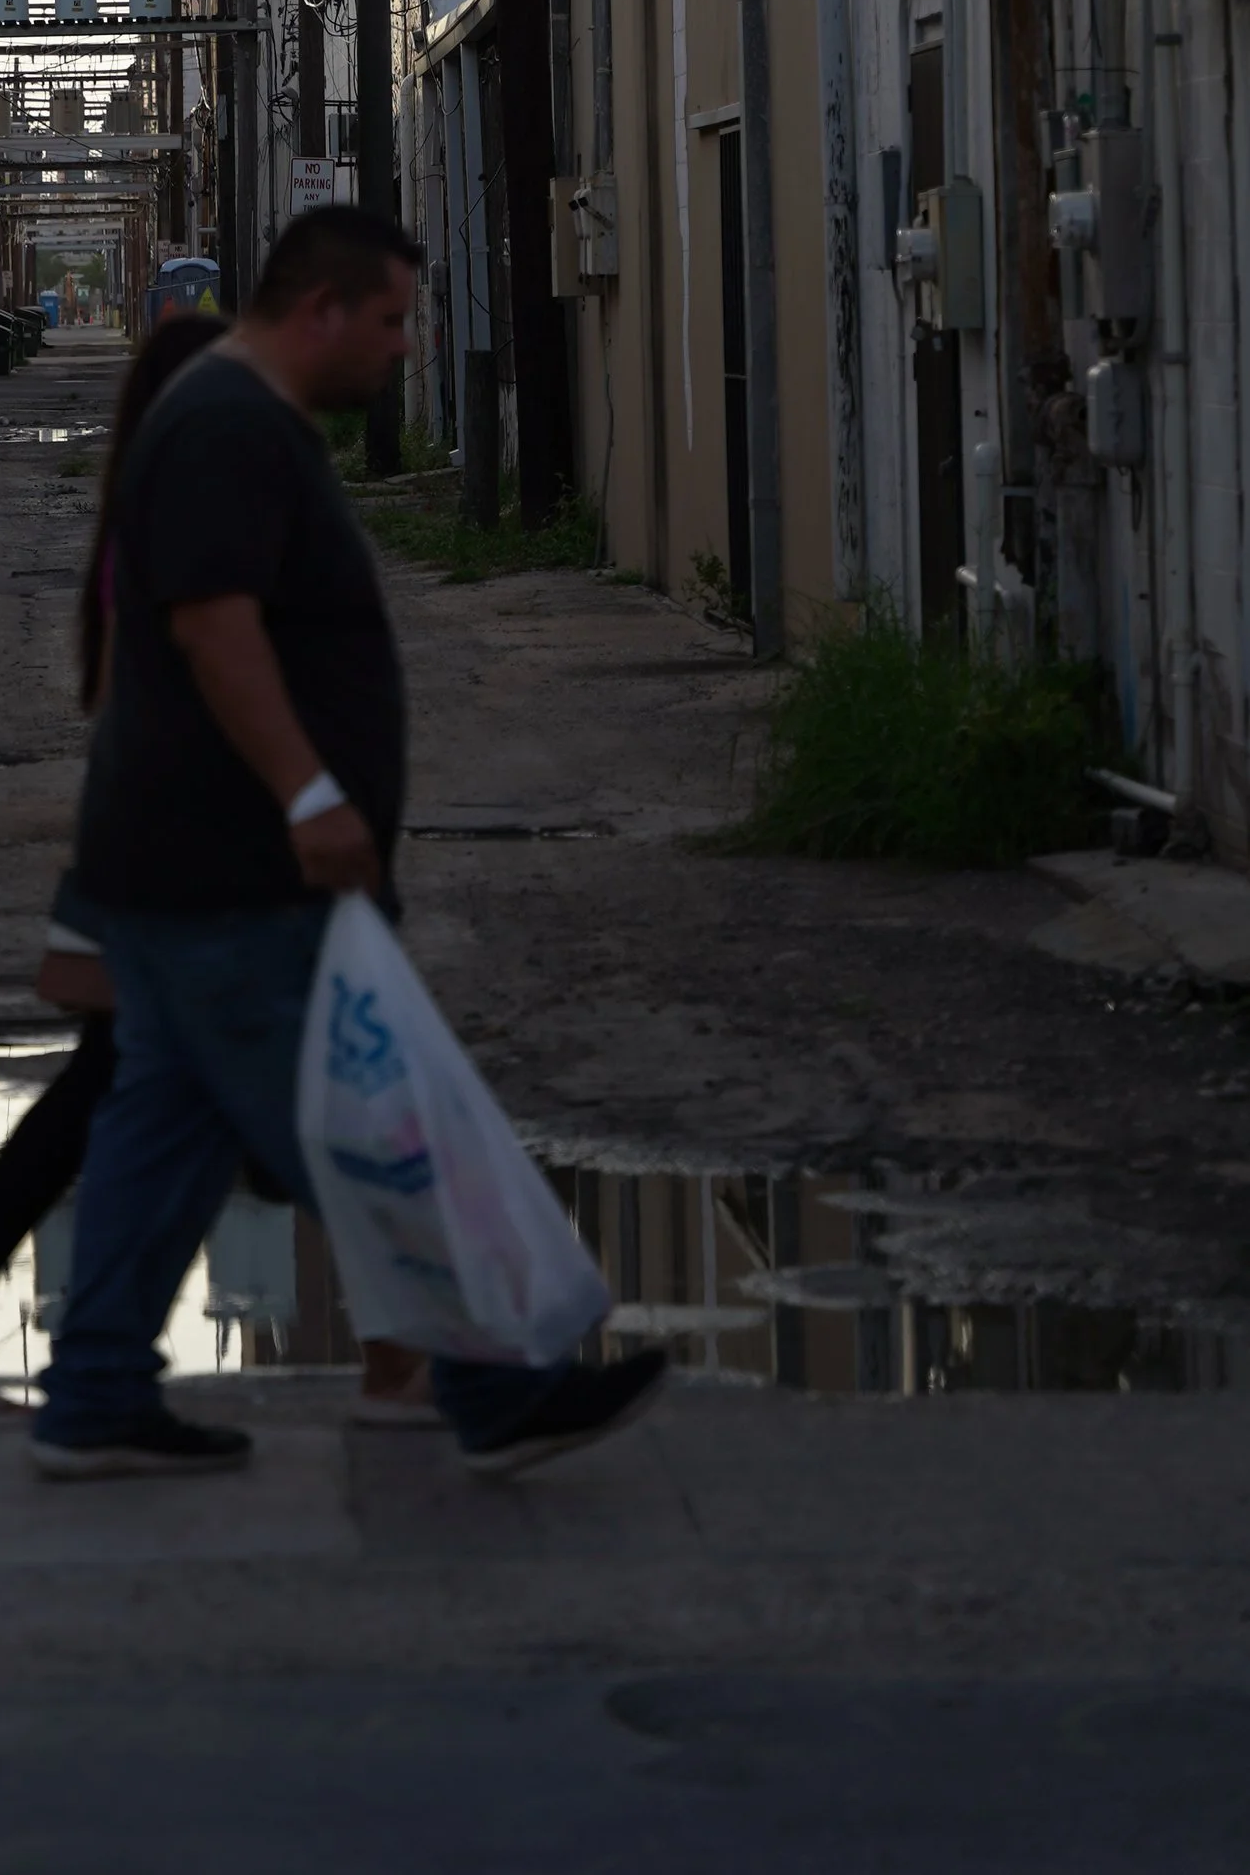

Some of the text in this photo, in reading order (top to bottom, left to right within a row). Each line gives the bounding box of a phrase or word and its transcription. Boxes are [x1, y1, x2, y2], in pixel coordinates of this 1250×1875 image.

[305, 163, 321, 175] NO
[294, 177, 331, 190] PARKING
[304, 193, 319, 201] ANY
